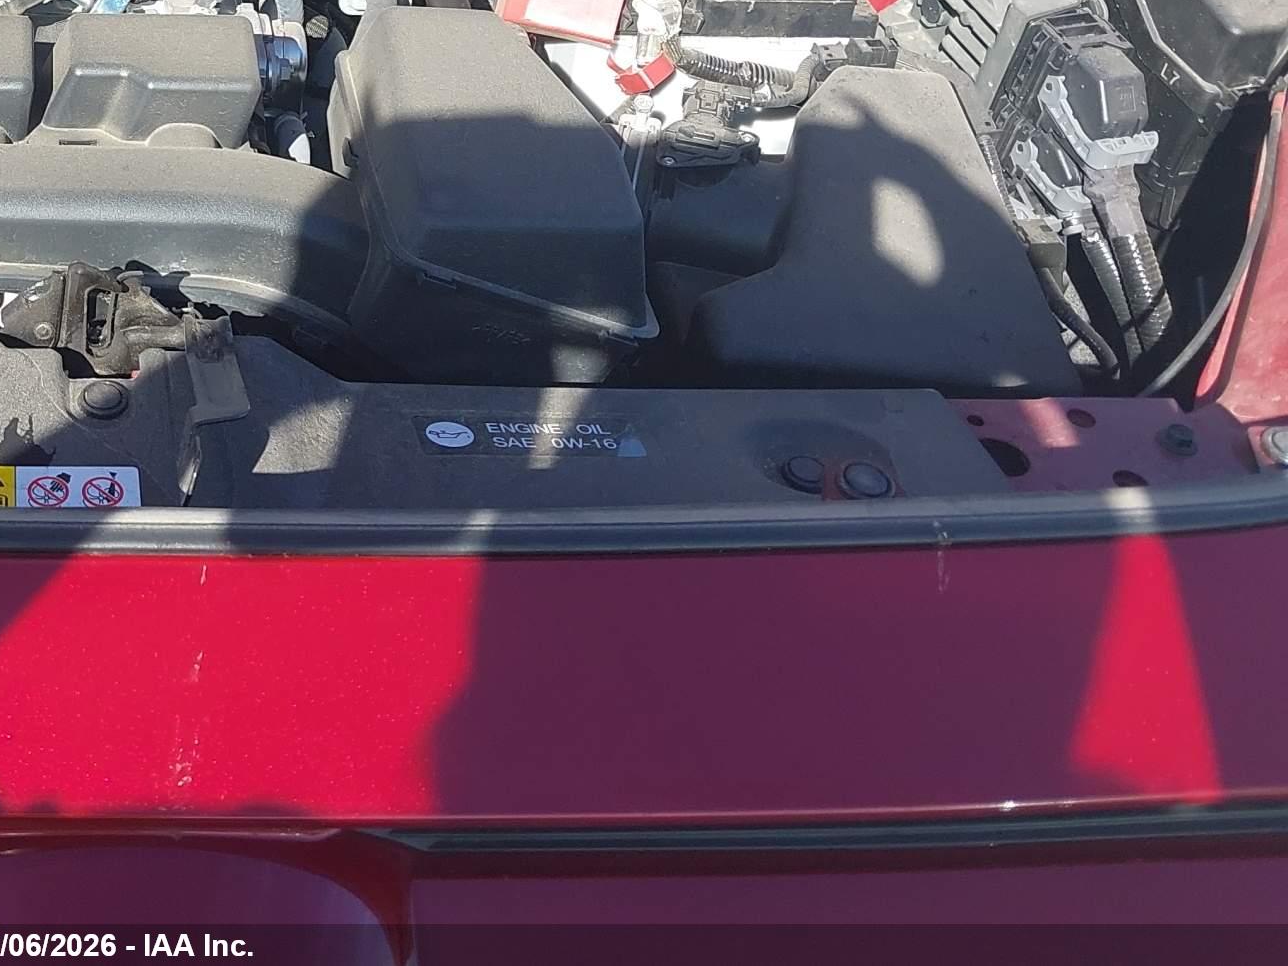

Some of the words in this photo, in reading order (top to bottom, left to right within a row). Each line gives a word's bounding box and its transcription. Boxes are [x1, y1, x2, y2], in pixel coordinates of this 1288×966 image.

[486, 422, 563, 434] ENGINE
[576, 424, 611, 435] OIL
[493, 437, 537, 448] SAE
[551, 437, 617, 449] 0W-16
